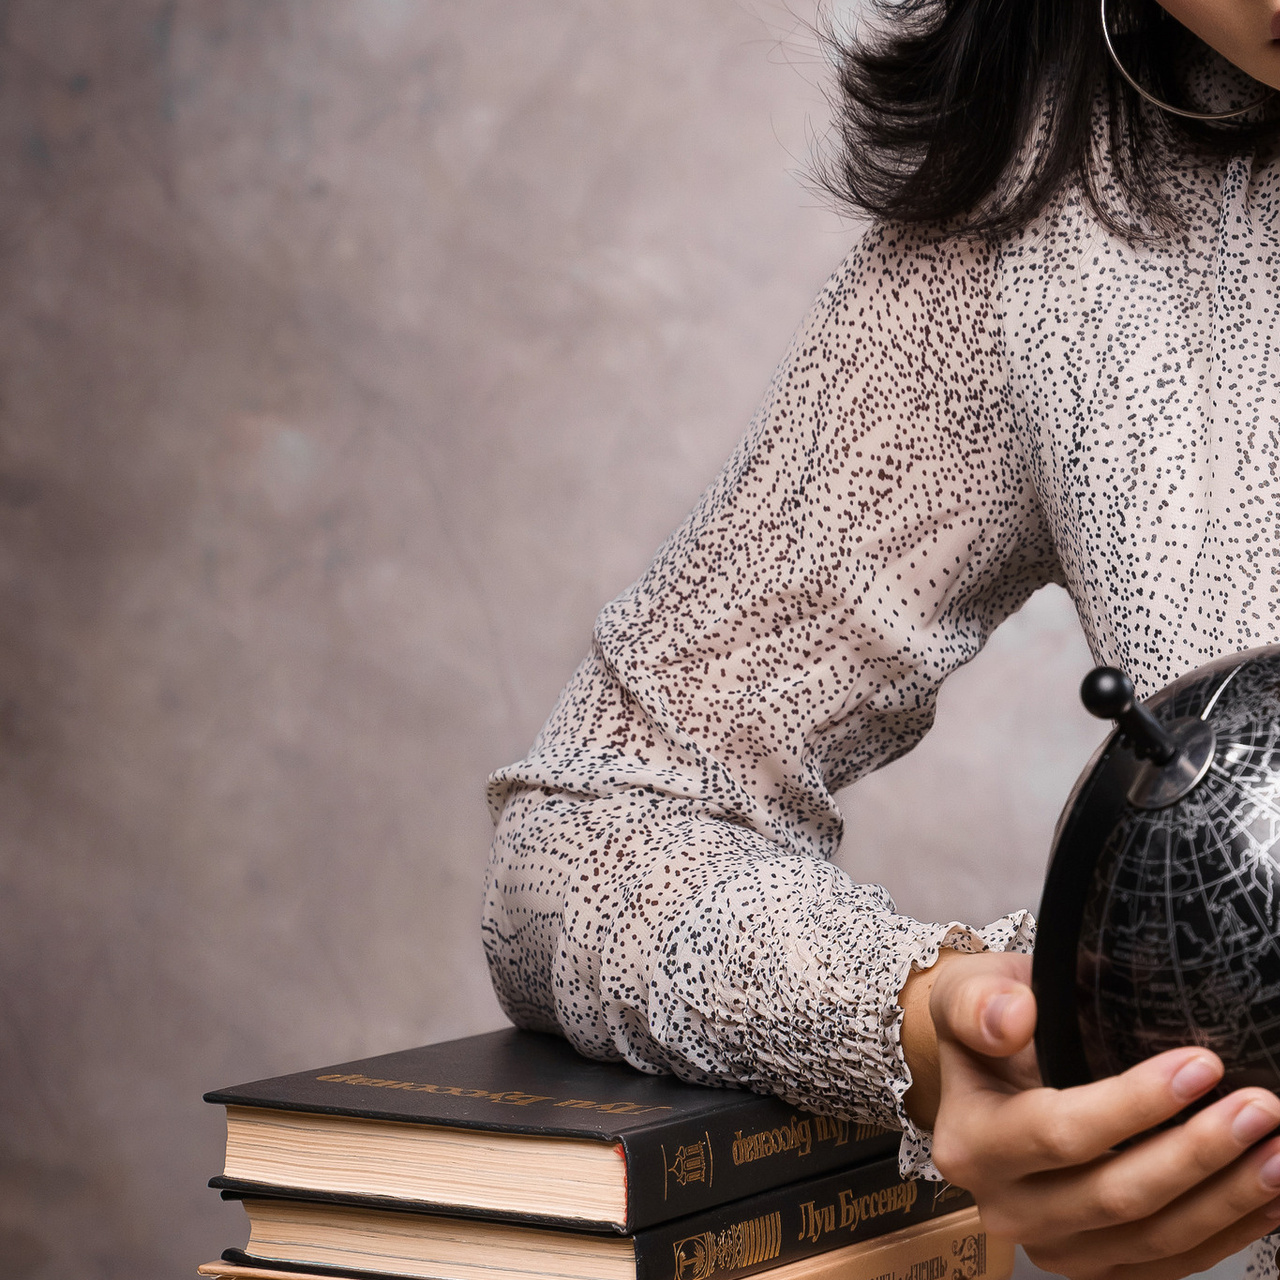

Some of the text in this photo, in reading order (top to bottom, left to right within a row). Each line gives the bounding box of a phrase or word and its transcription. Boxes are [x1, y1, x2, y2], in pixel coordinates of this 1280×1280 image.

[731, 1114, 849, 1167] Луи Буссенар
[798, 1180, 919, 1244] Луи Буссенар
